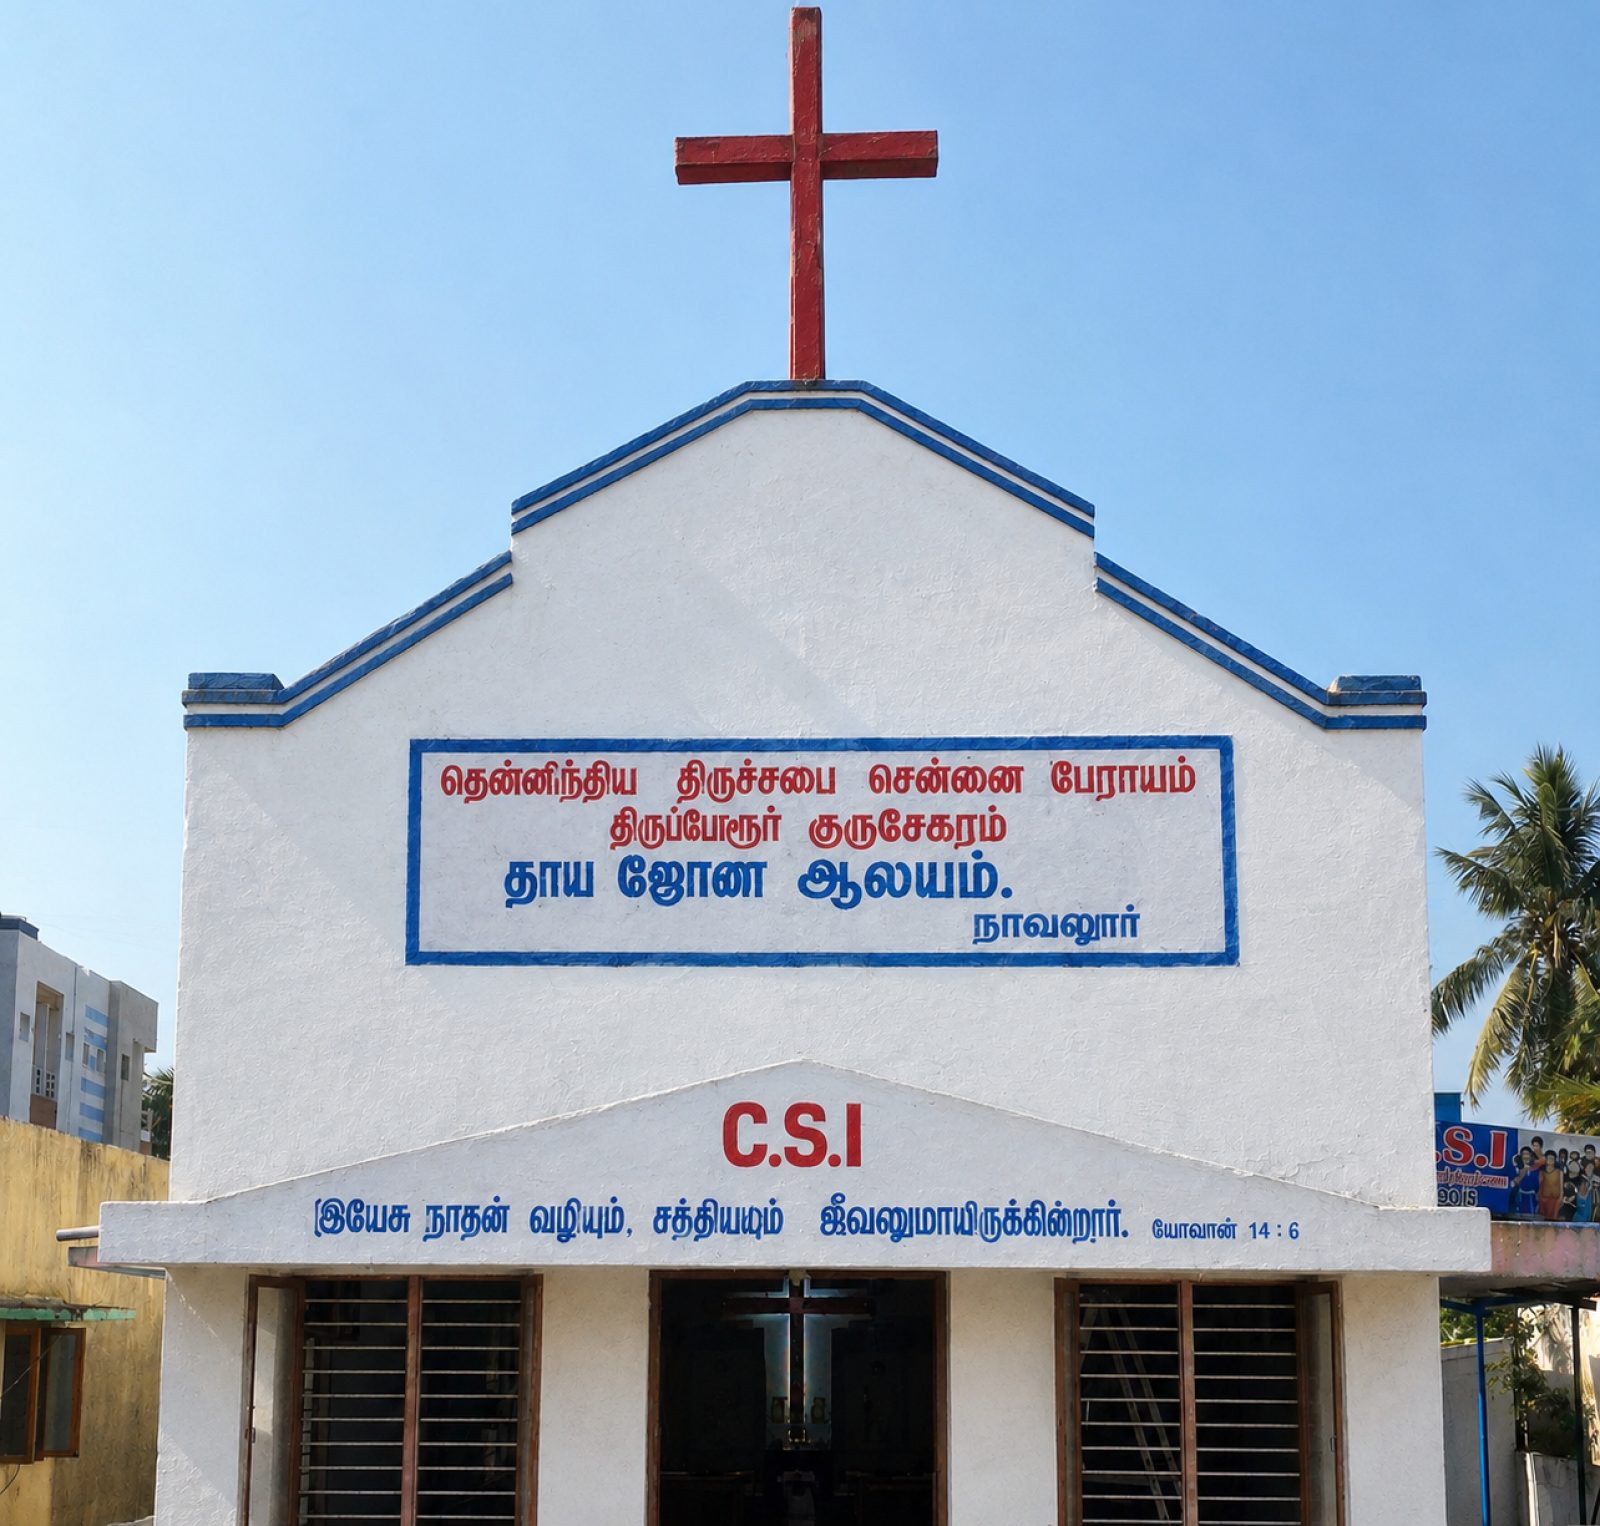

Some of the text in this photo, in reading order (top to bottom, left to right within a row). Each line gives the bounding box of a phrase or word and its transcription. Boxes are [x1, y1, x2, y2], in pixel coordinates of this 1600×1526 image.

[676, 758, 836, 804] திருச்சபை
[868, 756, 1025, 795] சென்னை
[1050, 754, 1196, 801] பேராயம்
[609, 804, 1007, 851] திருப்போரூர் குருசேகரம்
[796, 848, 1014, 911] ஆலயம்.
[722, 1101, 862, 1168] C.S.I
[421, 1194, 512, 1243] நாதன்
[1151, 1216, 1237, 1240] யோவான்
